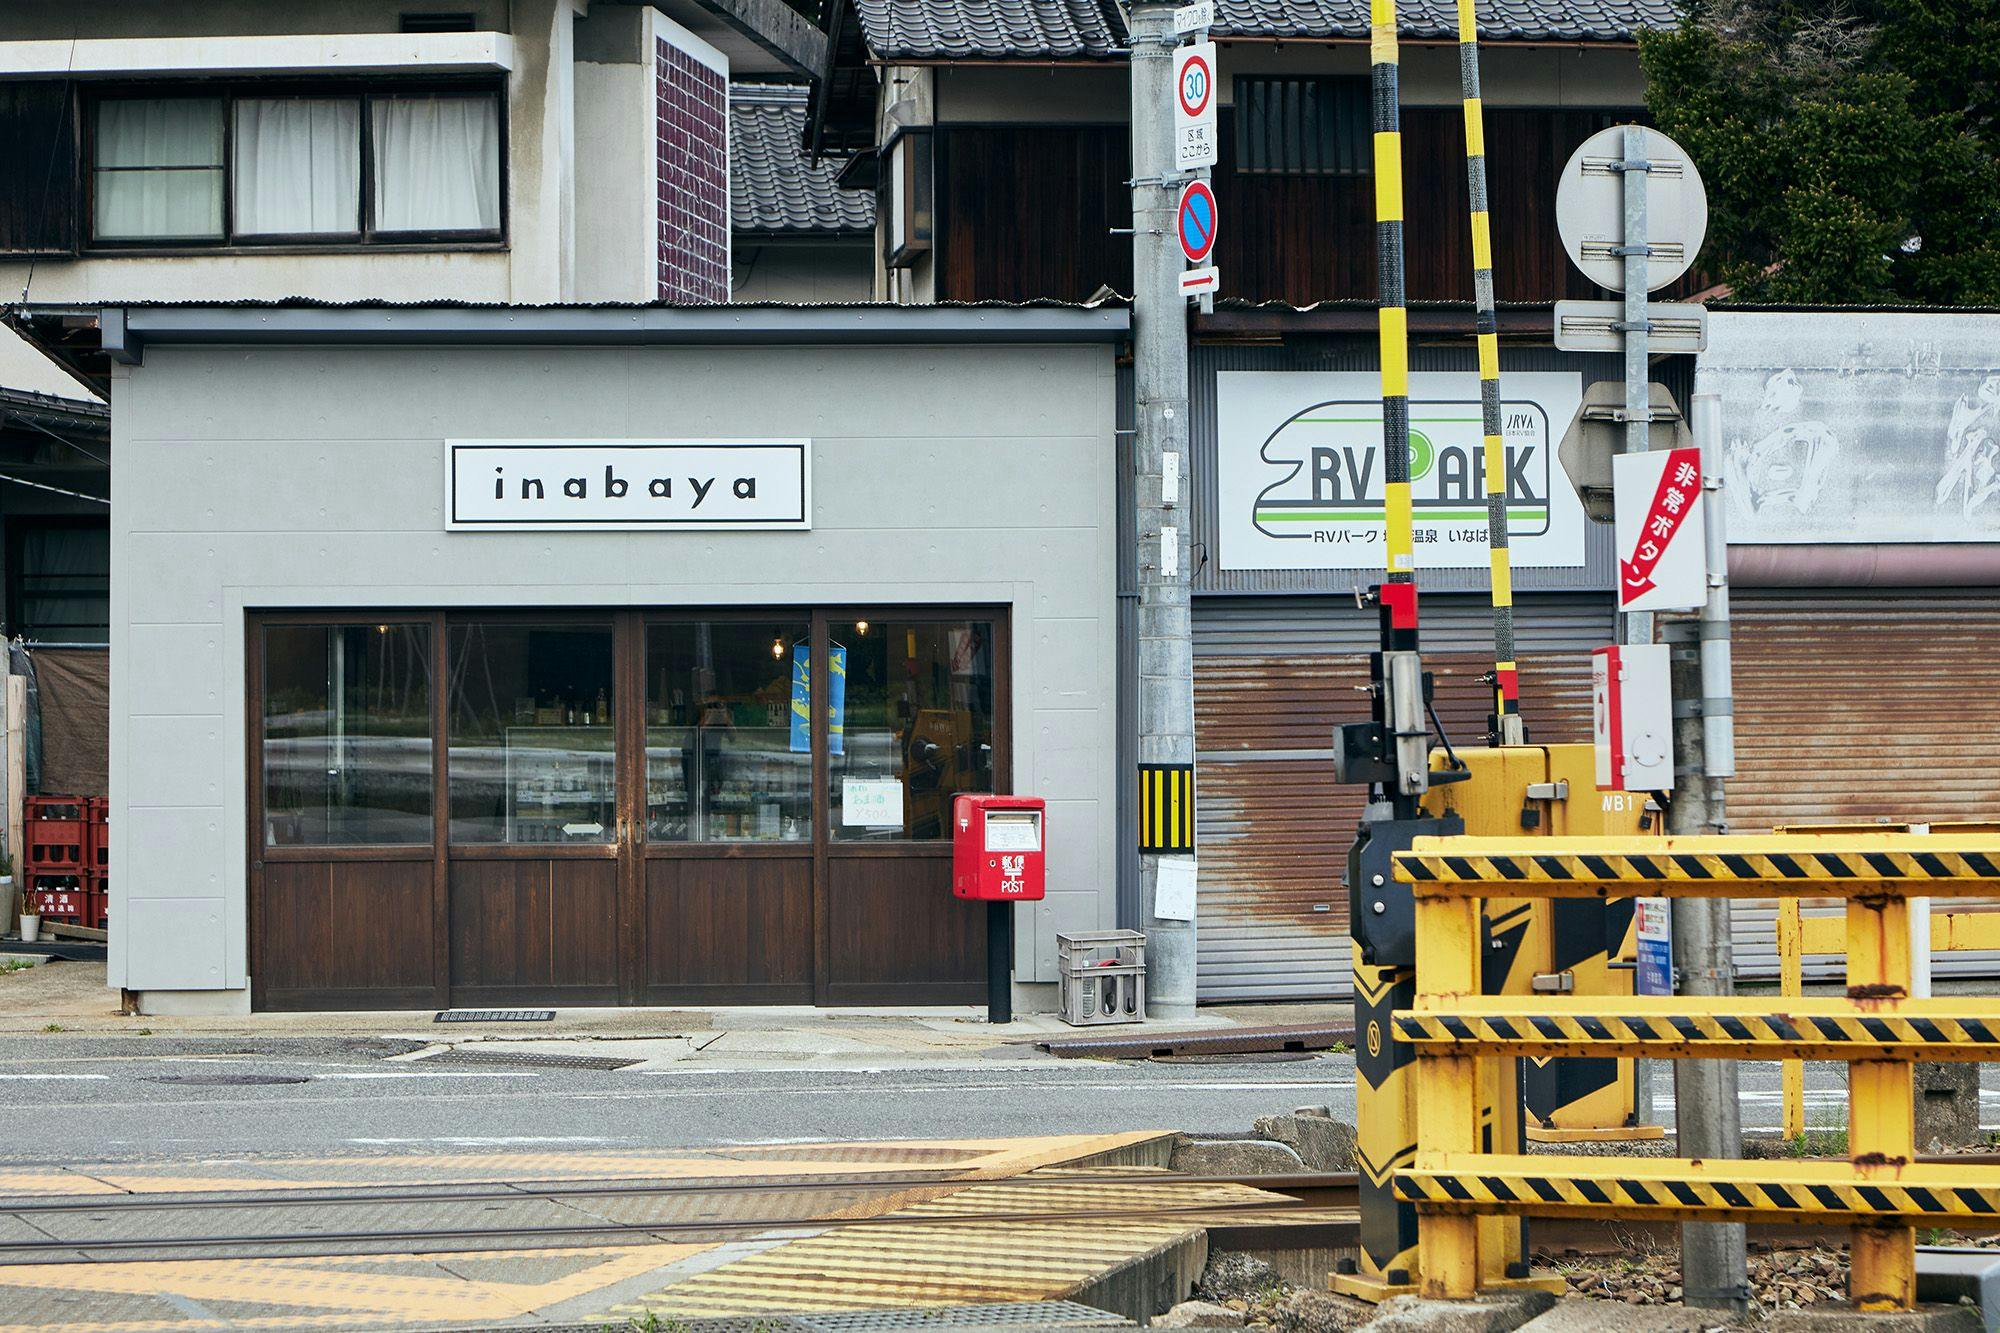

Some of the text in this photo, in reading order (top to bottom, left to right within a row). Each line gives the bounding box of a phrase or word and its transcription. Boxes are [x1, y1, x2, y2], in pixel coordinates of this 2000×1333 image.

[1186, 72, 1204, 100] 30
[1188, 128, 1204, 142] 区域
[1181, 143, 1210, 158] ここから
[1311, 446, 1376, 500] RV
[495, 465, 756, 509] inabaya
[1625, 461, 1698, 587] 非常ボタン
[1314, 530, 1378, 543] RVパーク
[1001, 855, 1025, 870] 郵便
[1001, 880, 1025, 893] POST
